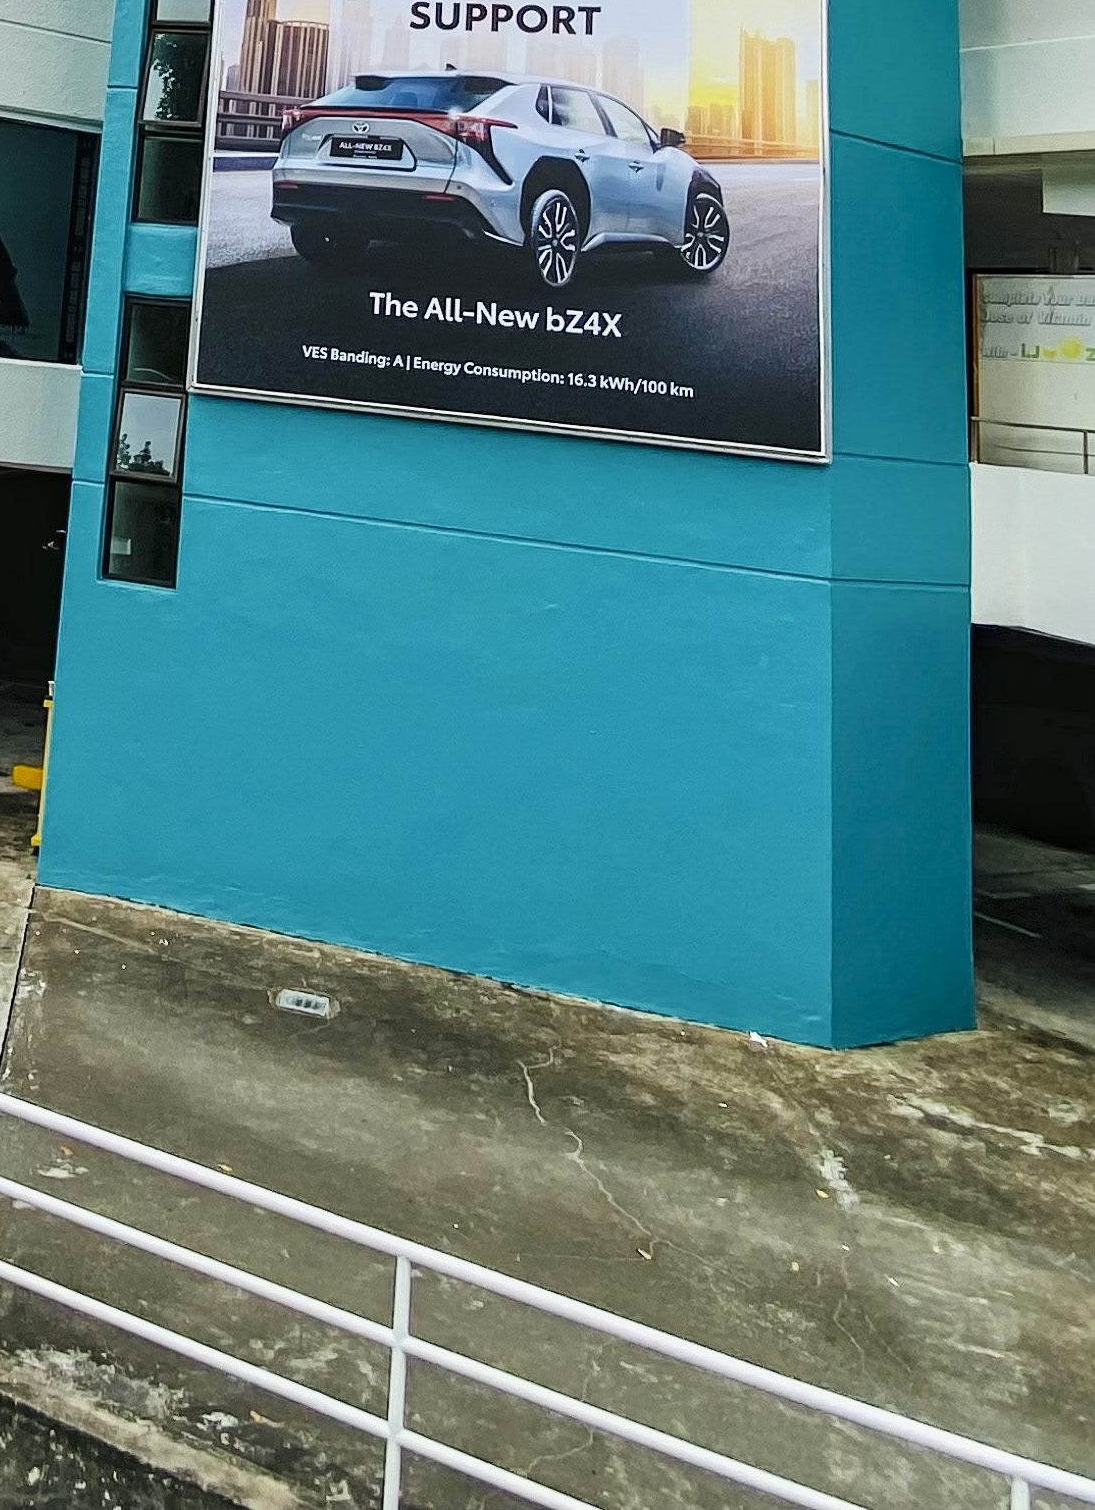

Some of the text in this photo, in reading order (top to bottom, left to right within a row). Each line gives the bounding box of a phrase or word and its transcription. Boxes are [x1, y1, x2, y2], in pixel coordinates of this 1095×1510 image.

[410, 2, 601, 35] SUPPORT
[369, 291, 623, 338] The All-New bZ4X
[302, 345, 327, 360] VES
[330, 348, 390, 369] Banding:
[392, 355, 404, 368] A
[413, 356, 462, 376] Energy
[464, 362, 565, 384] Consumption:
[567, 372, 597, 388] 16.3
[599, 375, 667, 395] kWh/100
[670, 382, 694, 398] km
